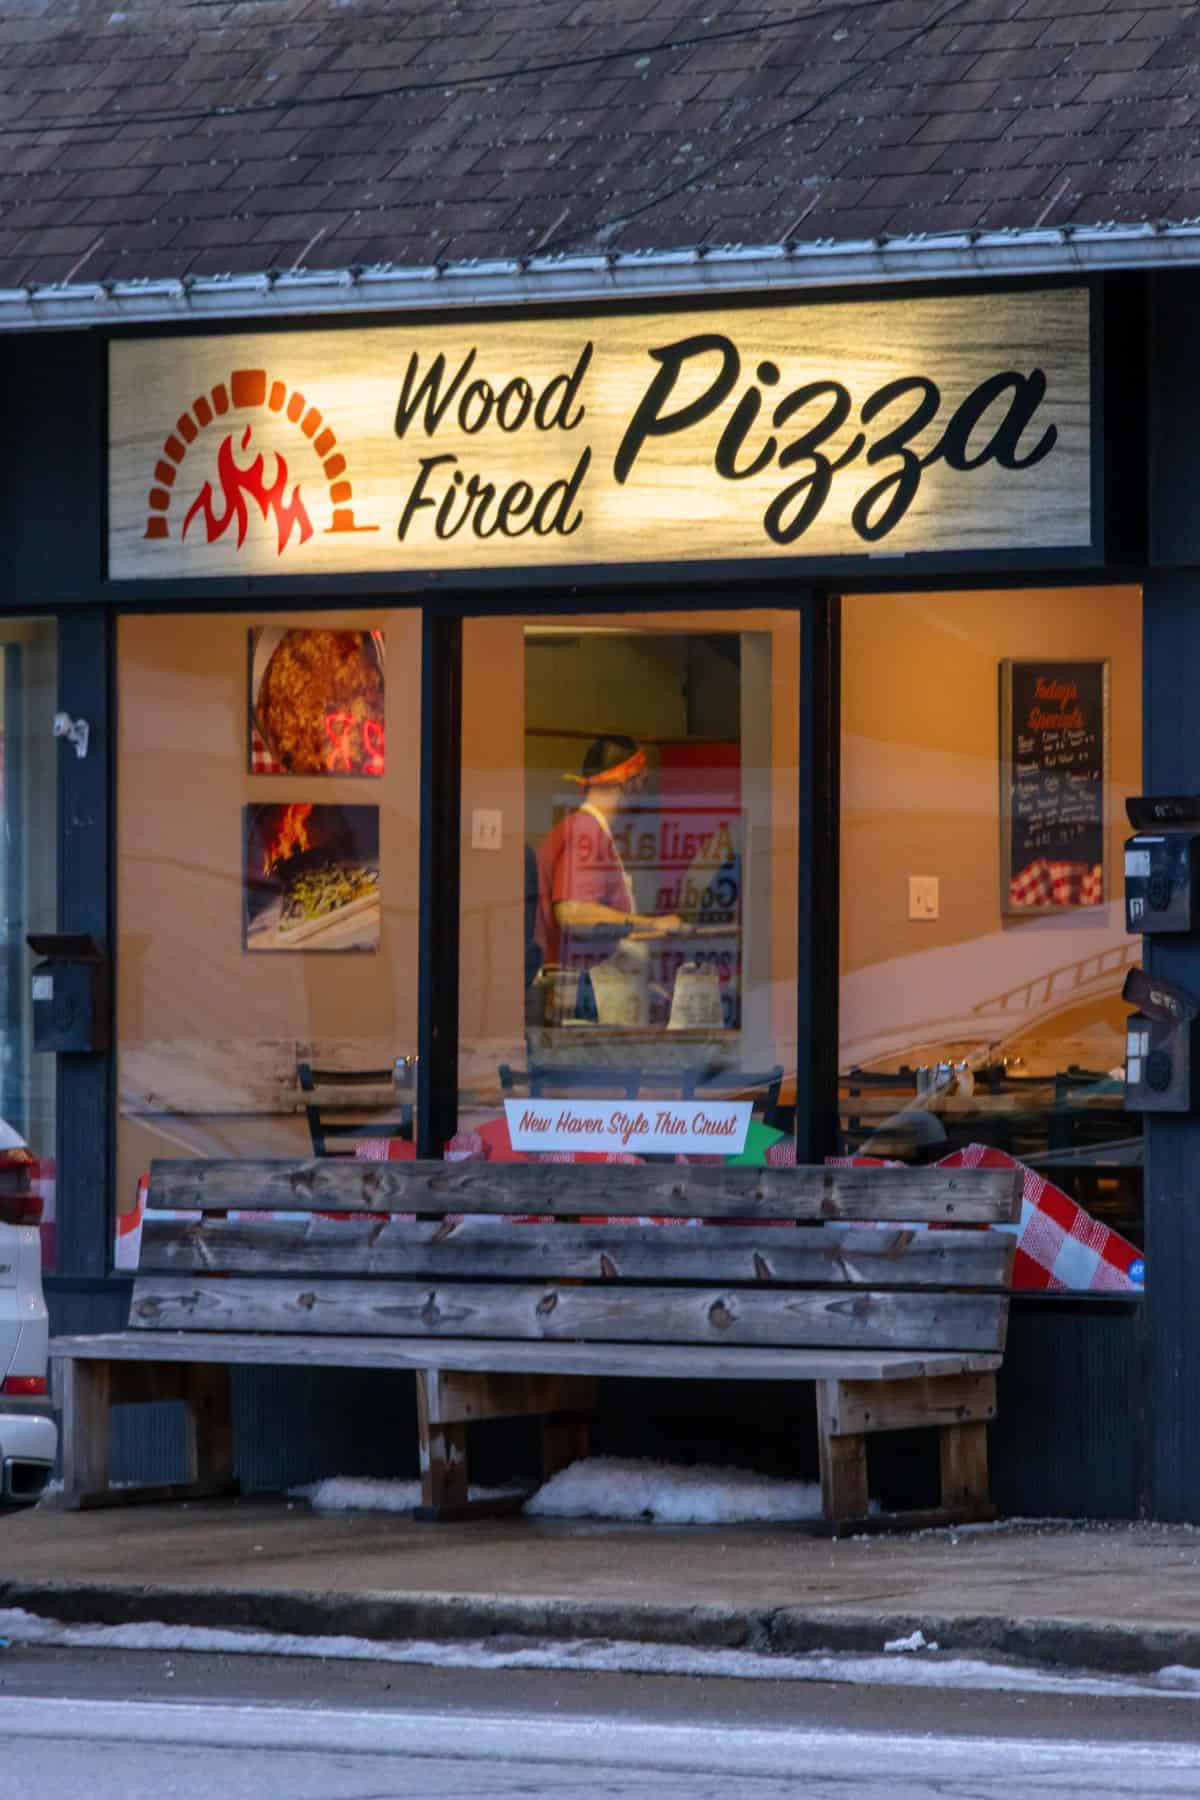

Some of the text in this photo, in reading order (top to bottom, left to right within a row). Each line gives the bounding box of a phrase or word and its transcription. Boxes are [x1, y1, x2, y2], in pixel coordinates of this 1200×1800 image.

[394, 341, 594, 439] Wood
[613, 333, 1058, 545] Pizza
[398, 446, 592, 541] Fired
[518, 1109, 738, 1145] New Haven Style Thin Crust
